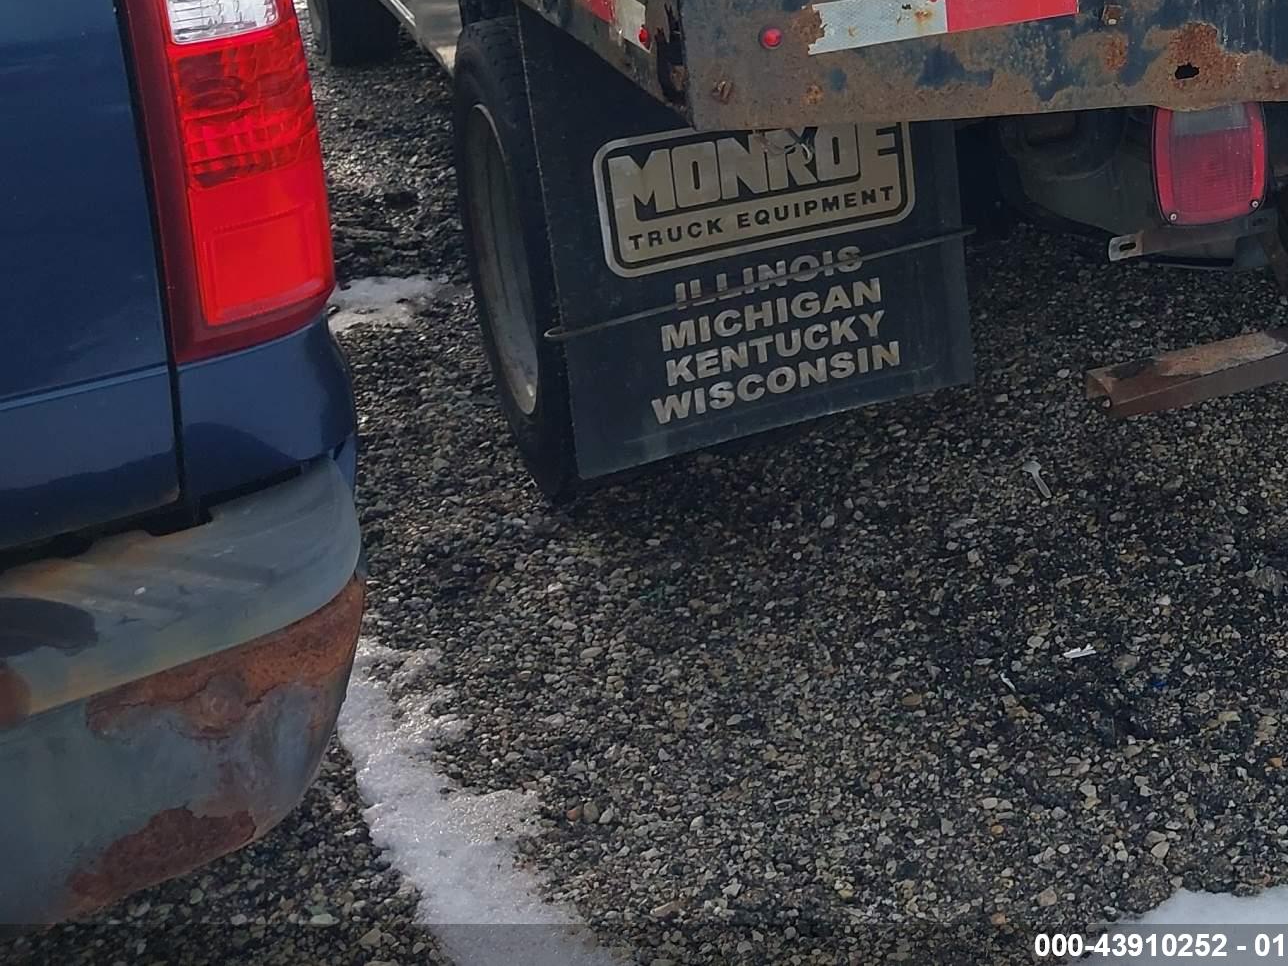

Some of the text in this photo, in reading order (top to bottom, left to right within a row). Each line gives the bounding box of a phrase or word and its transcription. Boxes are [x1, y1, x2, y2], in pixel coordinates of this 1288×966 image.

[607, 121, 898, 214] MONROE
[628, 186, 895, 251] TRUCK EQUIPMENT
[660, 277, 882, 352] MICHIGAN
[674, 246, 863, 309] ILLINOIS
[651, 340, 900, 424] WISCONSIN
[665, 310, 883, 386] KENTUCKY
